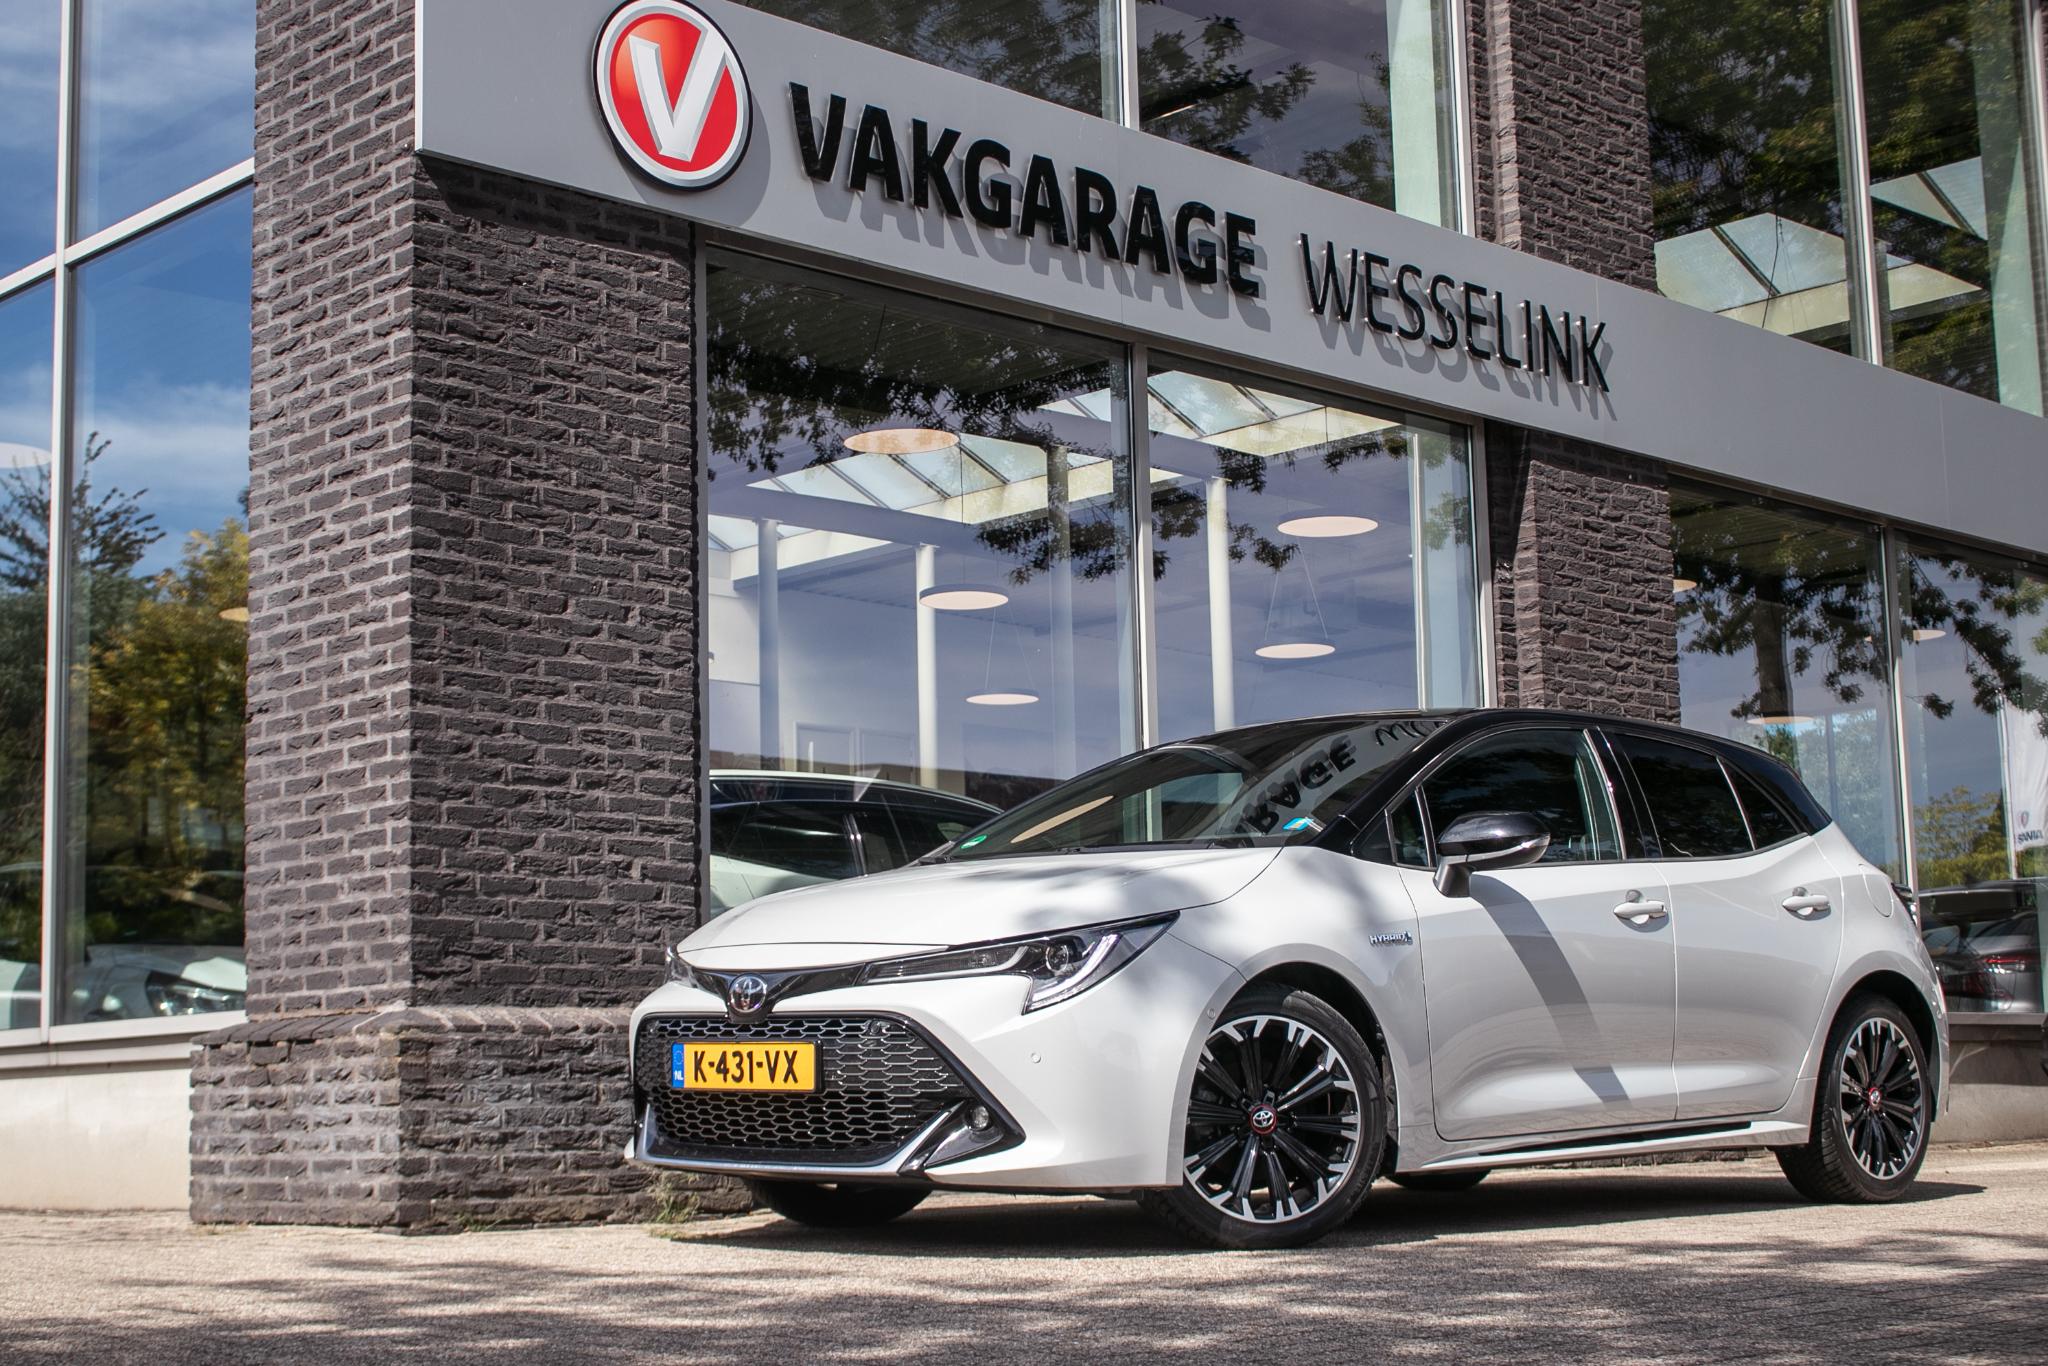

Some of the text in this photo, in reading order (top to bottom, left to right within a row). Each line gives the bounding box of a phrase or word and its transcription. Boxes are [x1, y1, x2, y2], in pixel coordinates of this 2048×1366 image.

[788, 81, 1610, 393] VAKGARAGE WESSELINK
[674, 1070, 684, 1081] NL
[693, 1050, 799, 1084] K-431-VX
